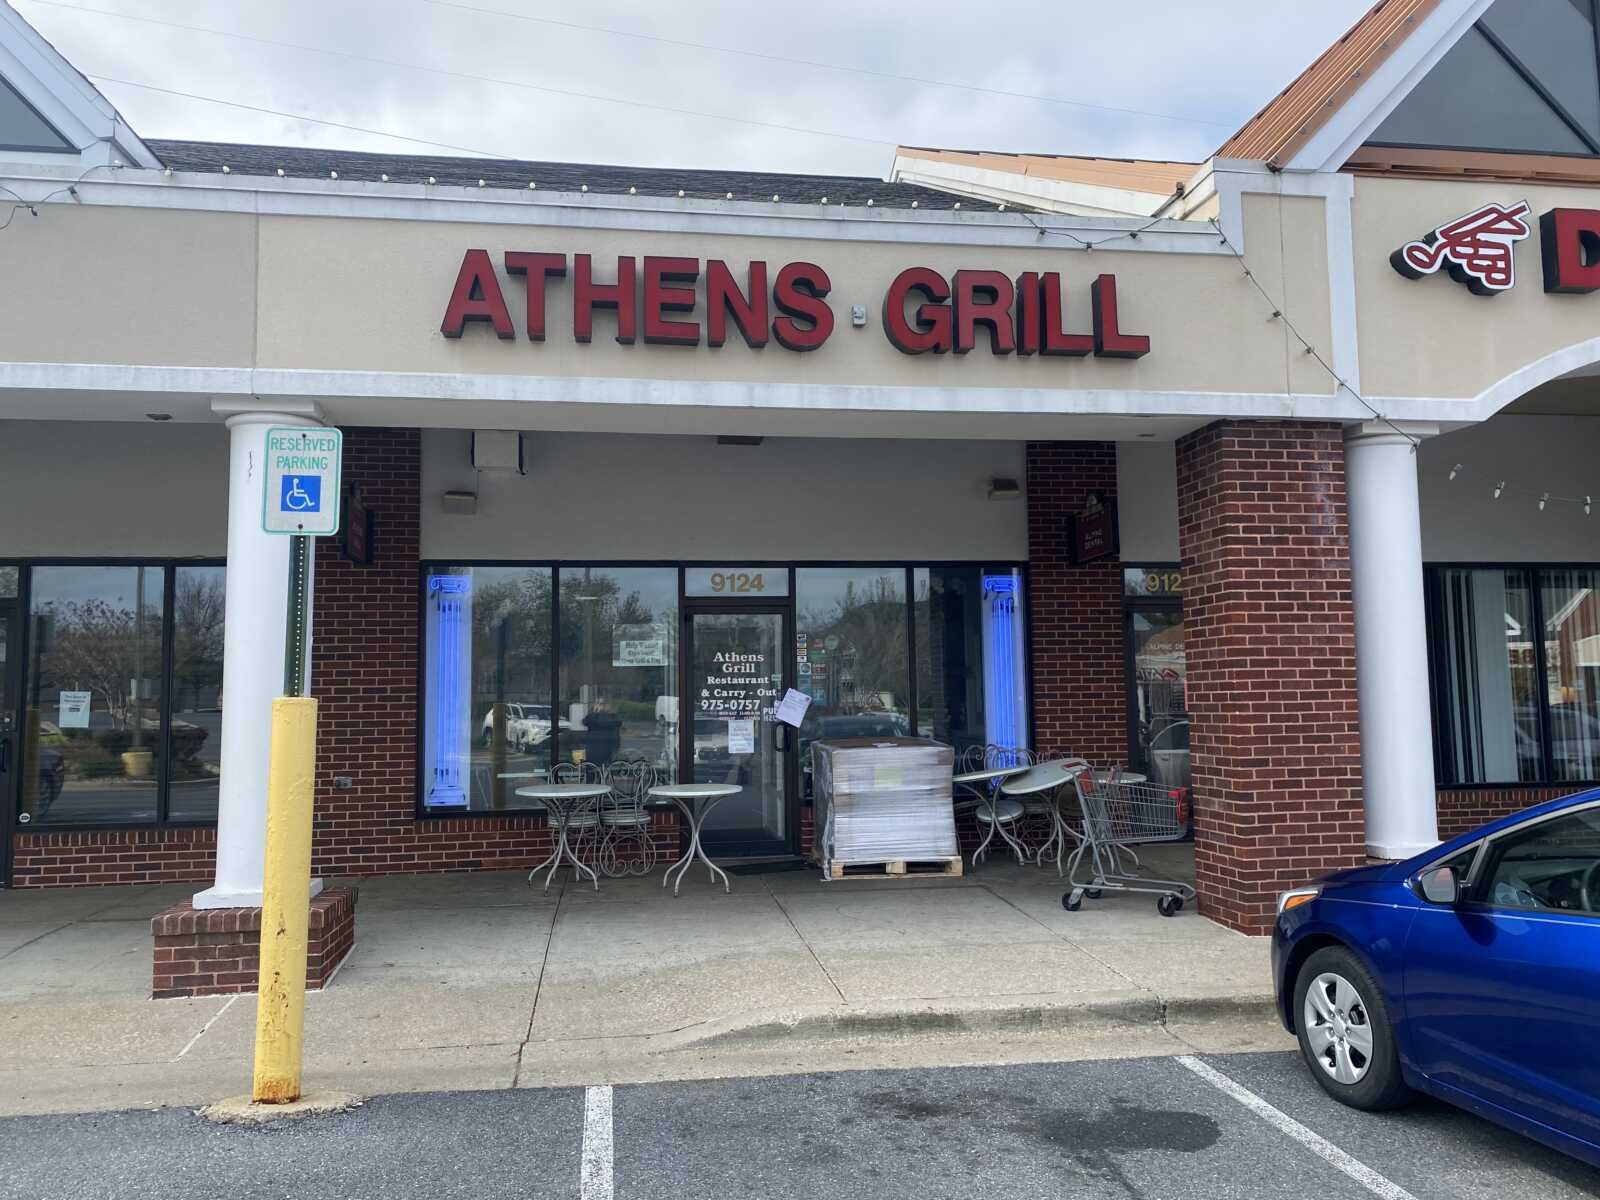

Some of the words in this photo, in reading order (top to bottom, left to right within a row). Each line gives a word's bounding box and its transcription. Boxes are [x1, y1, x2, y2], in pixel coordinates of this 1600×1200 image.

[440, 249, 835, 351] ATHENS
[883, 266, 1150, 358] GRILL
[271, 436, 336, 451] RESERVED
[276, 455, 328, 470] PARKING
[711, 573, 765, 592] 9124
[713, 652, 764, 662] Athens
[722, 663, 756, 673] Grill
[707, 676, 769, 685] Restaurant
[701, 689, 710, 697] &
[714, 689, 746, 698] Carry
[701, 700, 760, 710] 975-0757
